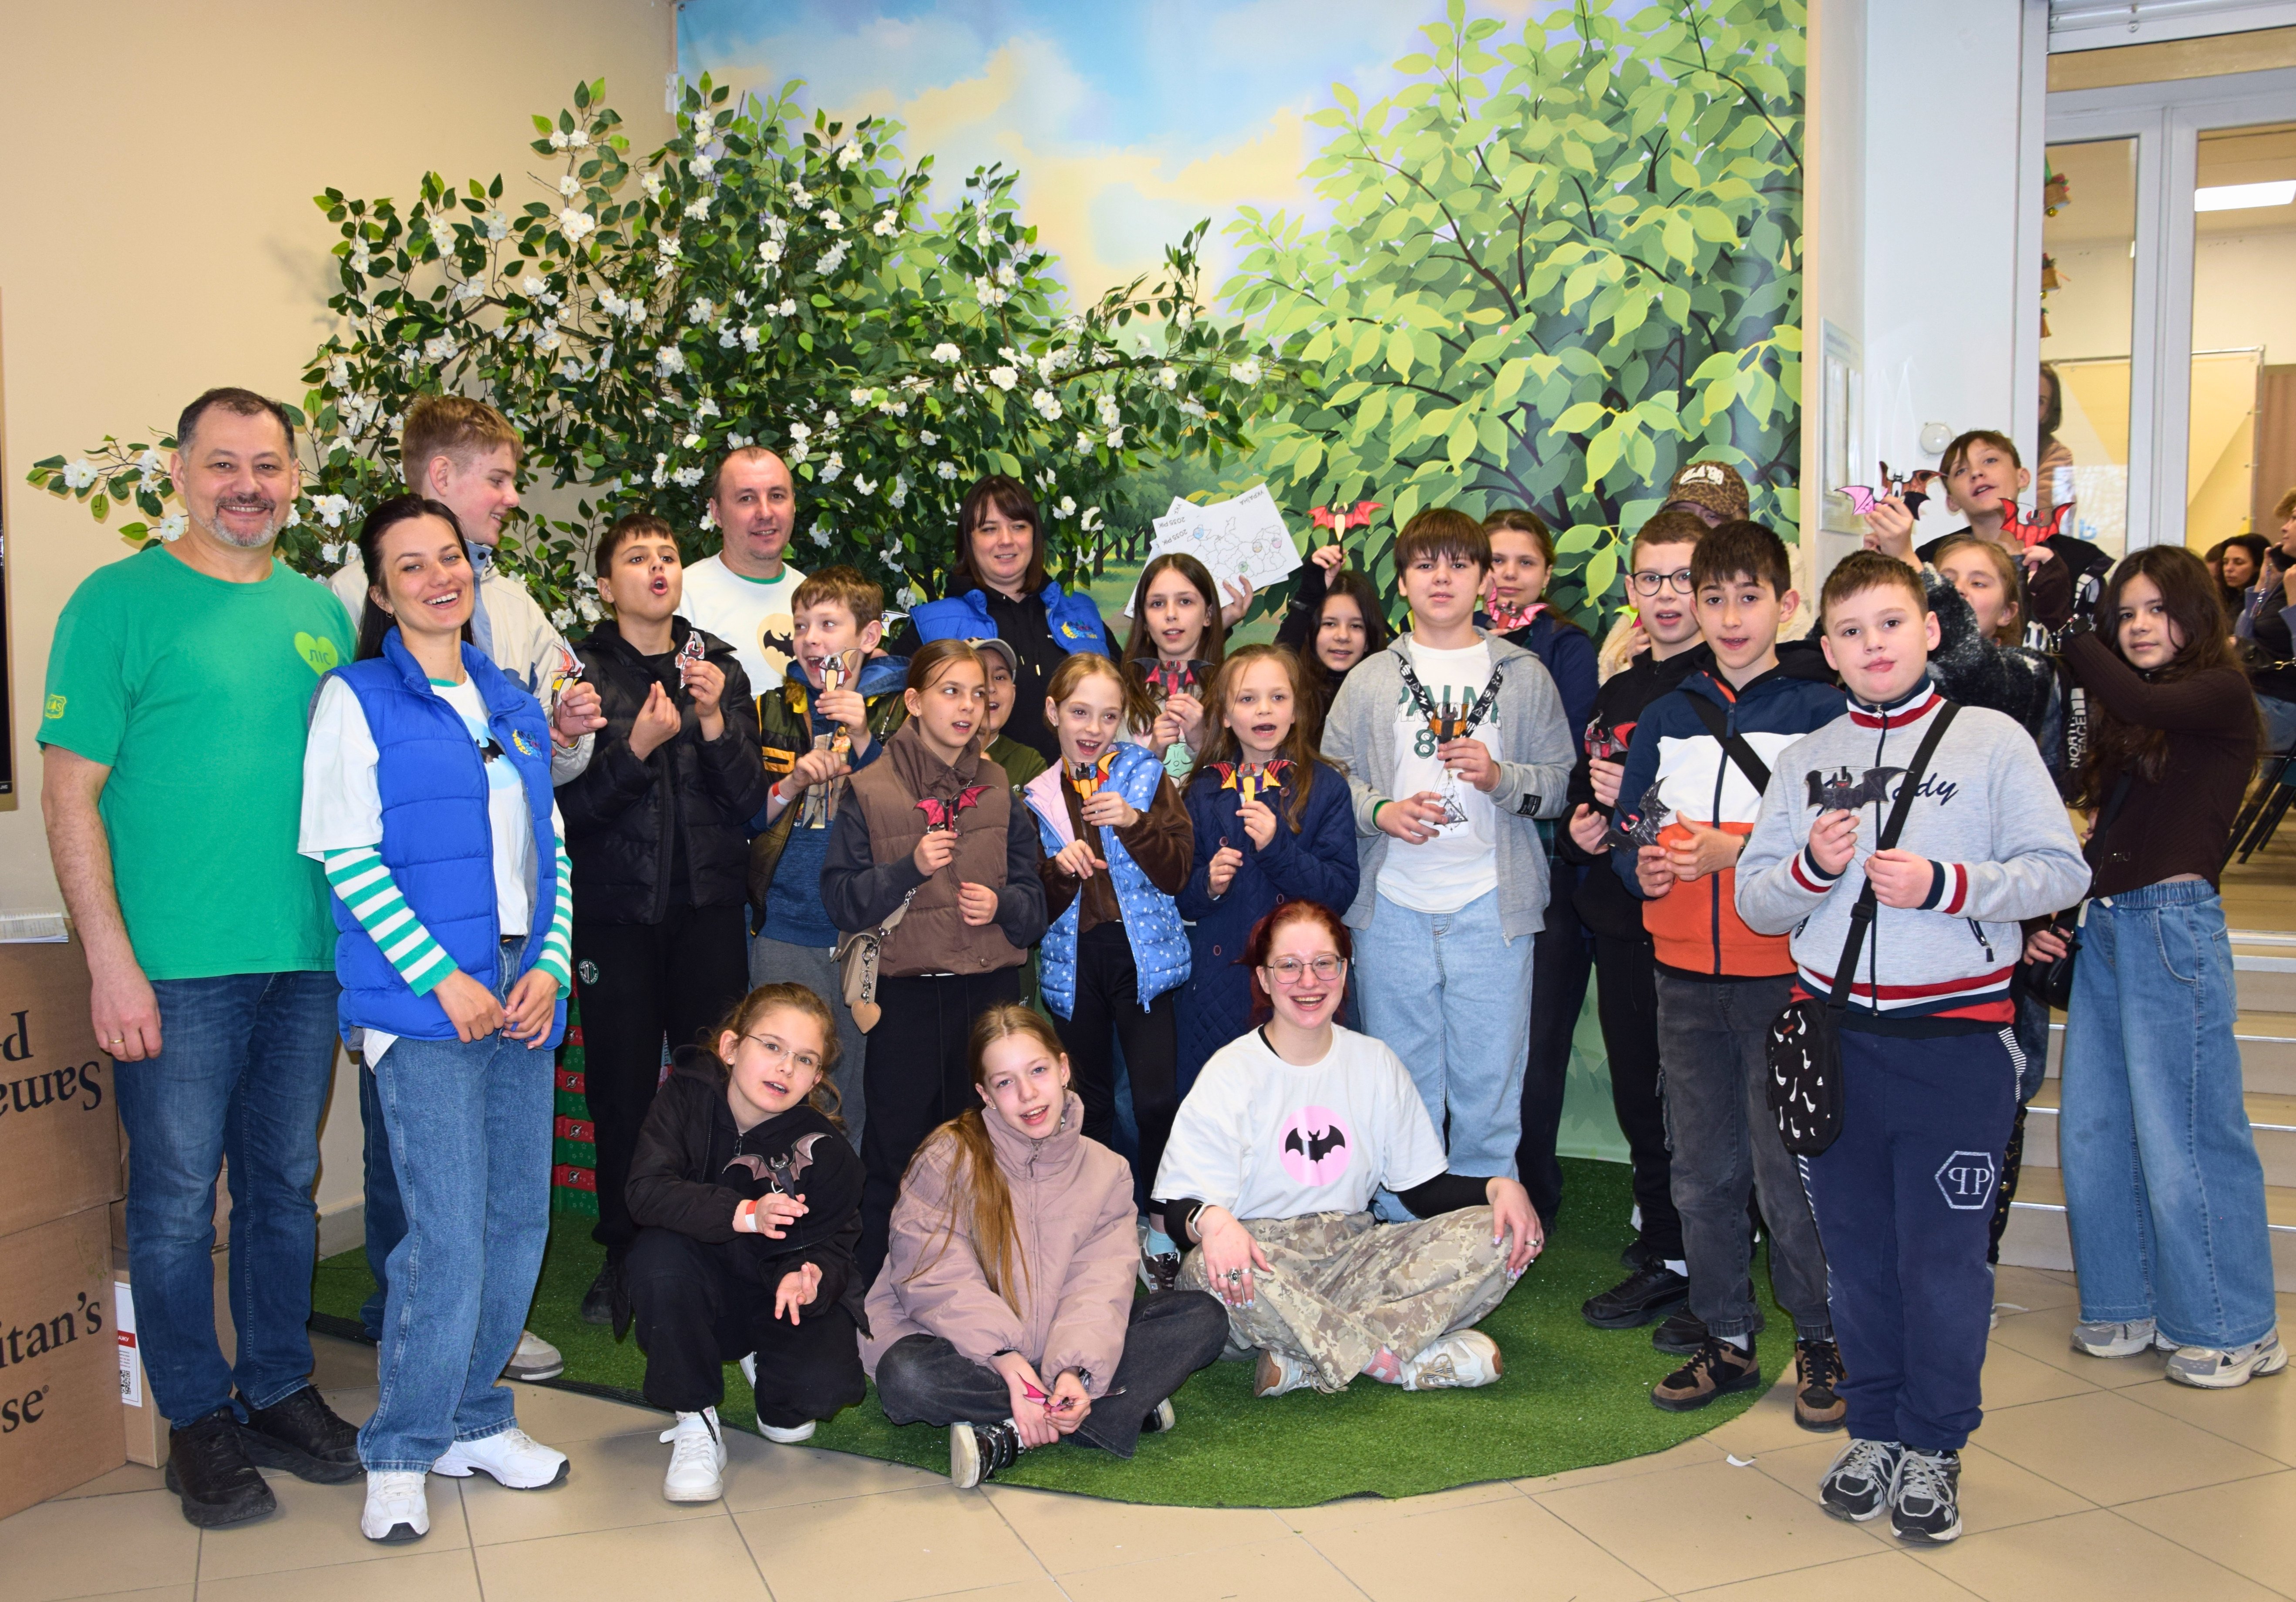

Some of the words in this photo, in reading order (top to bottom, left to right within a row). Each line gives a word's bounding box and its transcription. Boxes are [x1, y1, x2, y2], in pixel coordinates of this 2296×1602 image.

[1239, 490, 1264, 505] УКРАЇНА
[1169, 517, 1185, 526] 2035
[1172, 529, 1188, 541] 2035
[310, 649, 331, 666] ЛІС
[2075, 716, 2088, 754] FACE
[0, 1010, 34, 1061] P
